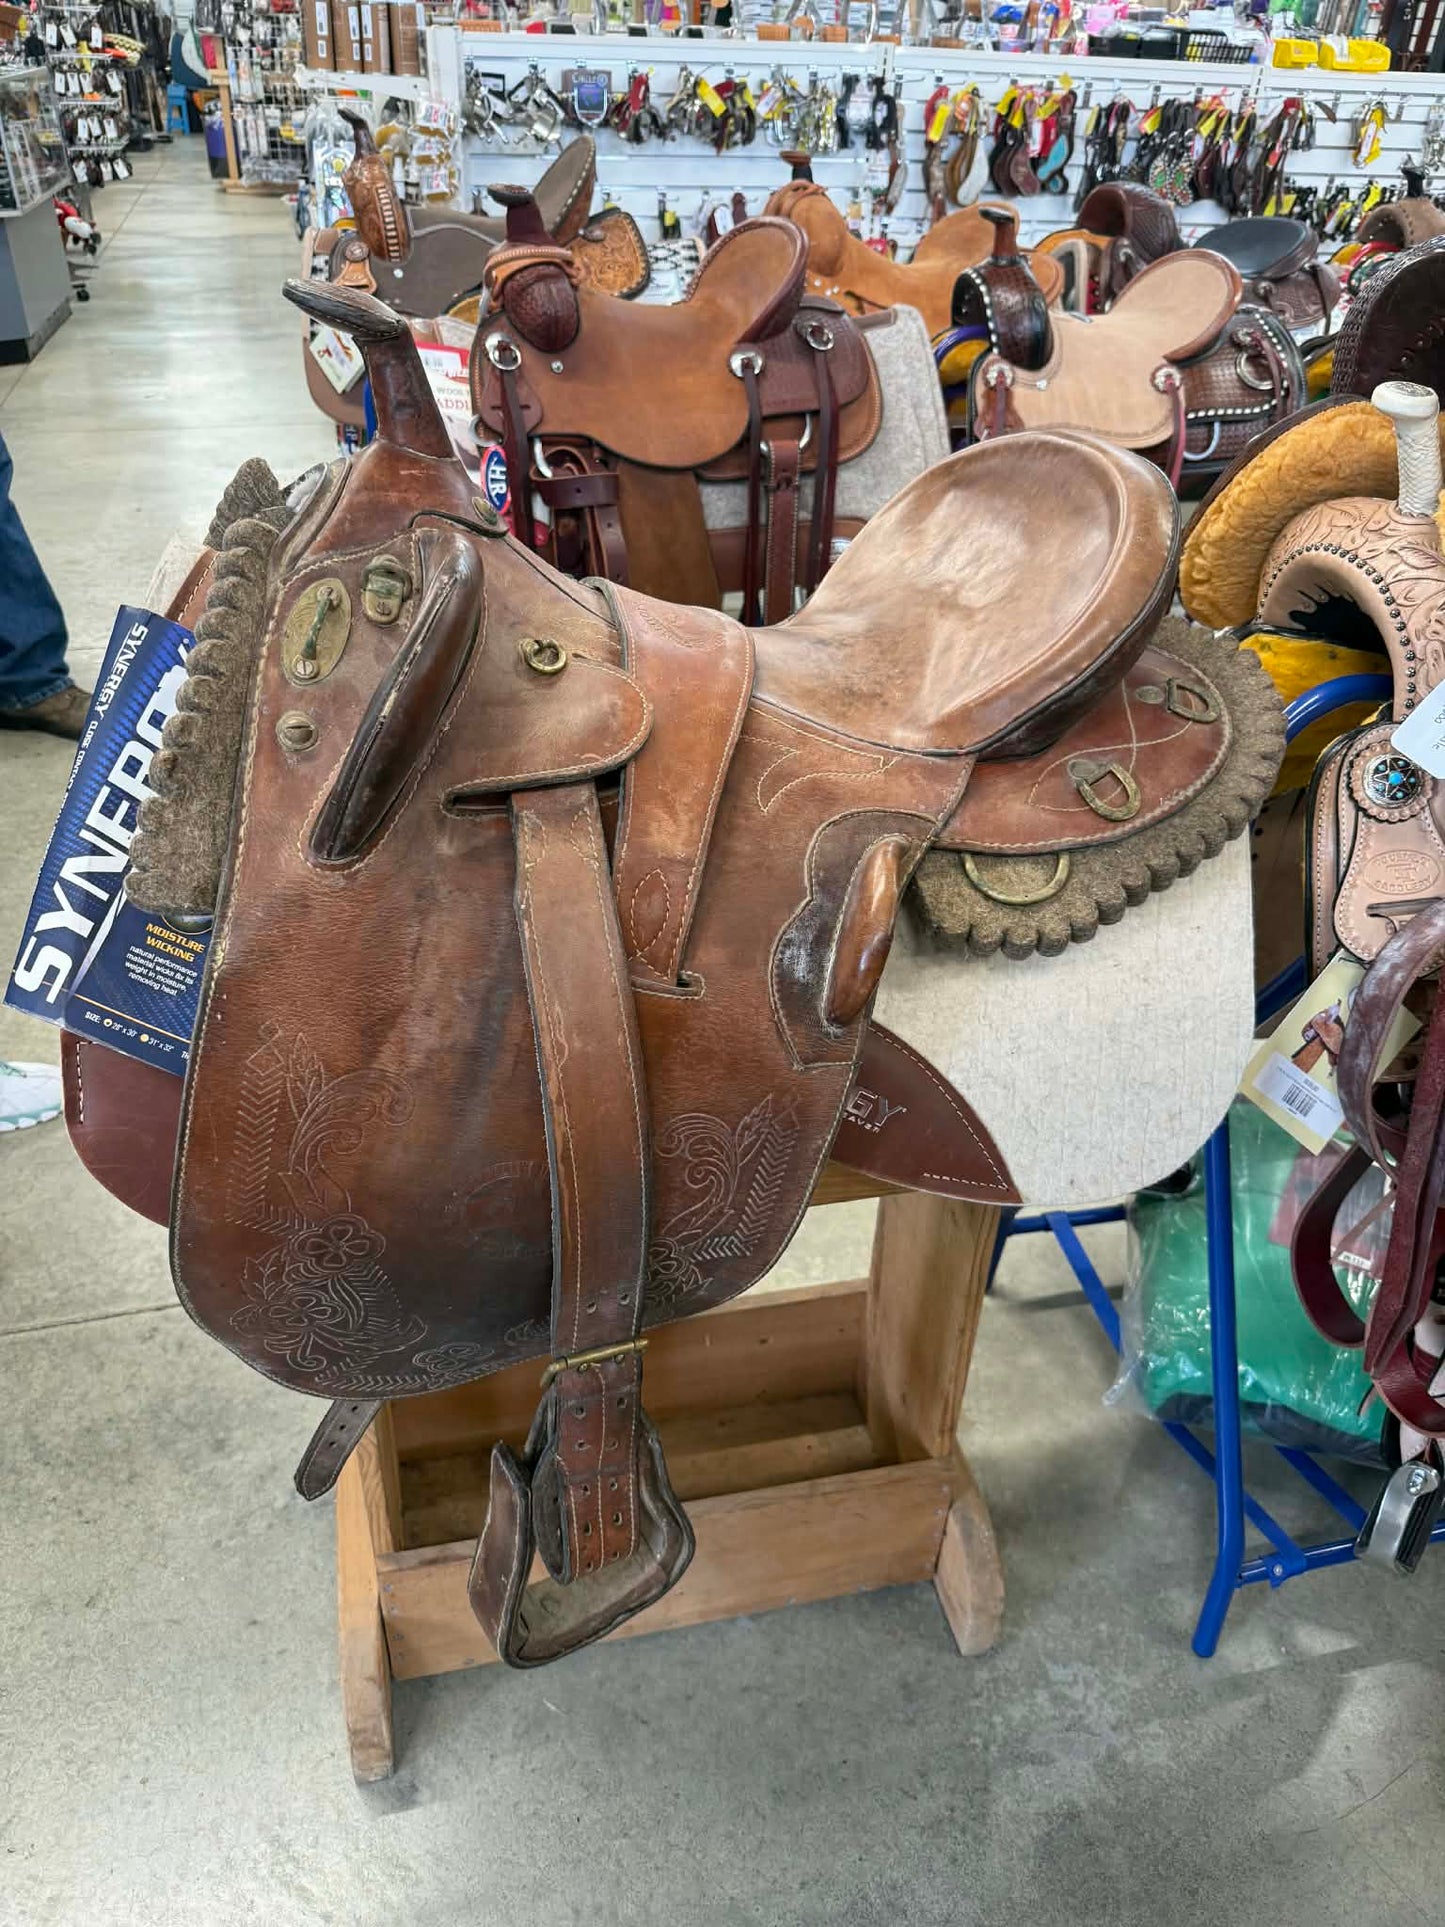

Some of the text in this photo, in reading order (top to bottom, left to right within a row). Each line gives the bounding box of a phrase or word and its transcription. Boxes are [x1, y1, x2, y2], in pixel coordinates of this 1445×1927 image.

[95, 622, 149, 720] SYNERGY
[81, 720, 99, 749] CLOSE
[146, 923, 206, 953] MOISTURE
[146, 936, 195, 962] WICKING
[126, 953, 156, 969] material
[155, 965, 175, 977] wicks
[184, 976, 195, 985] its
[129, 945, 198, 977] natural performance
[125, 961, 187, 992] weight in moisture,
[128, 972, 178, 996] removing heat
[85, 1011, 101, 1024] SIZE:
